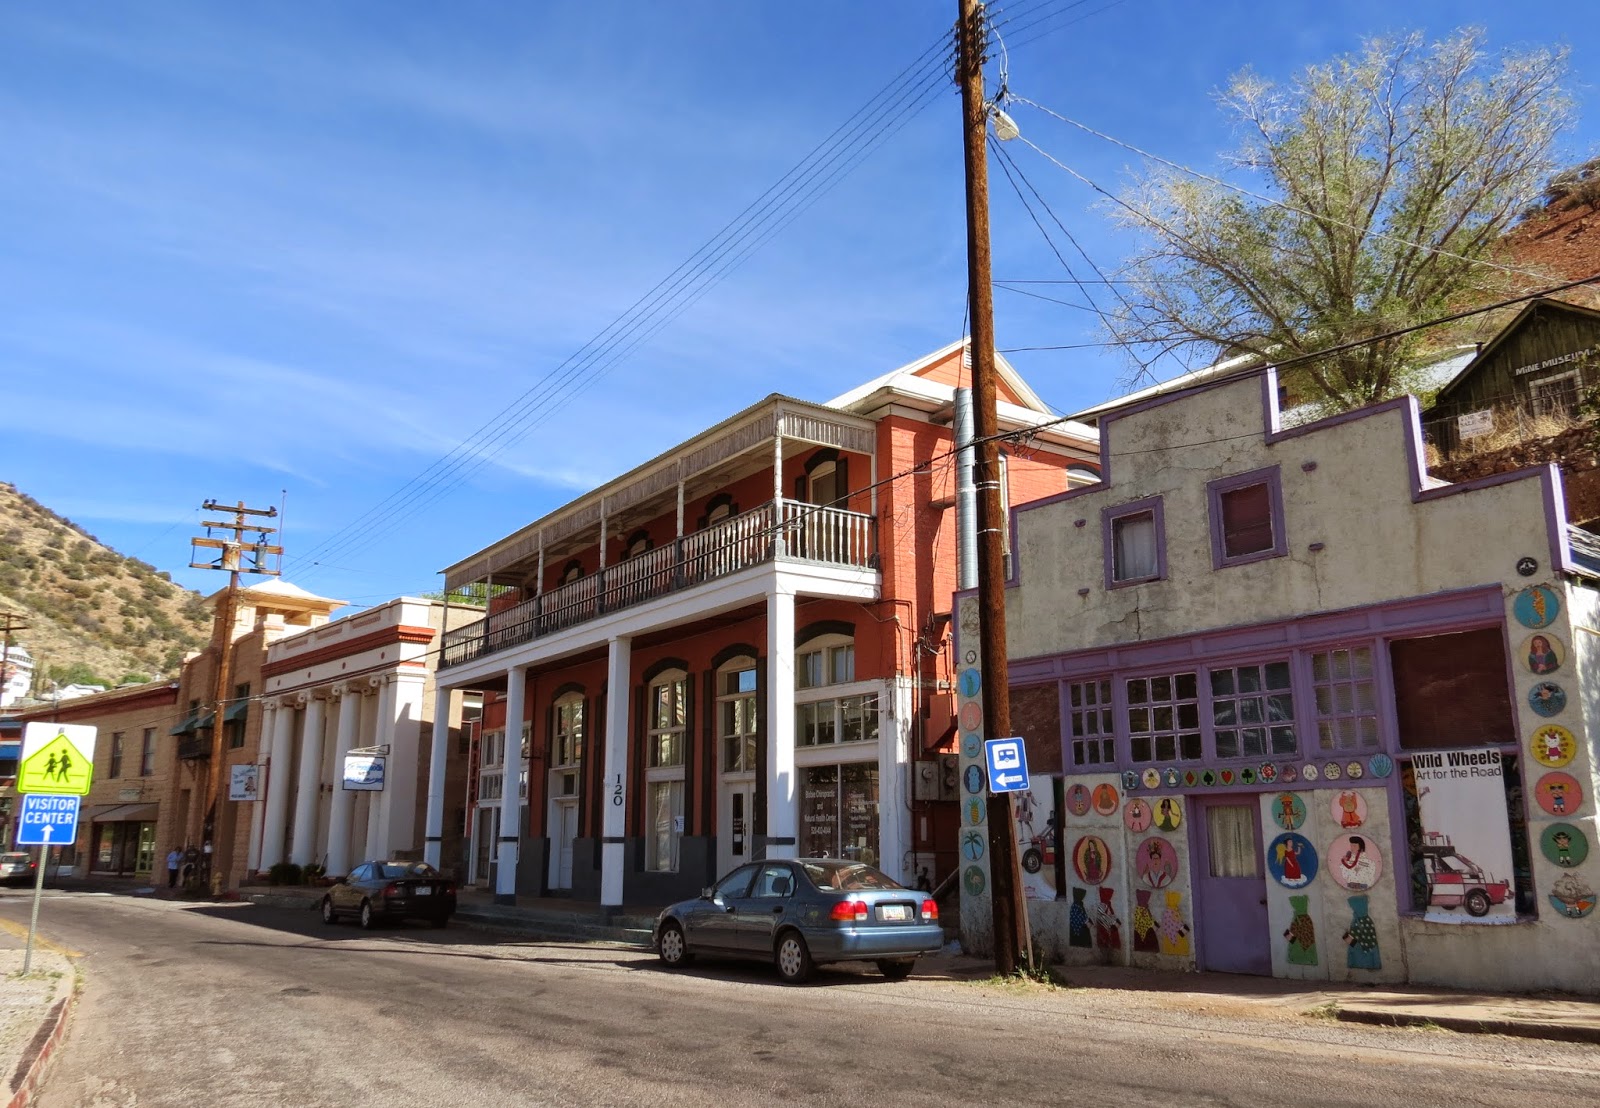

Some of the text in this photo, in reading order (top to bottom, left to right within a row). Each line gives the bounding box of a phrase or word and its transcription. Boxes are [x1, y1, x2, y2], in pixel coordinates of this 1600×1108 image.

[1412, 750, 1500, 769] Wild Wheels
[1416, 766, 1501, 780] Art for the Road
[613, 773, 623, 806] 120
[28, 797, 76, 811] VISITOR
[25, 811, 74, 825] CENTER
[826, 814, 837, 822] Center
